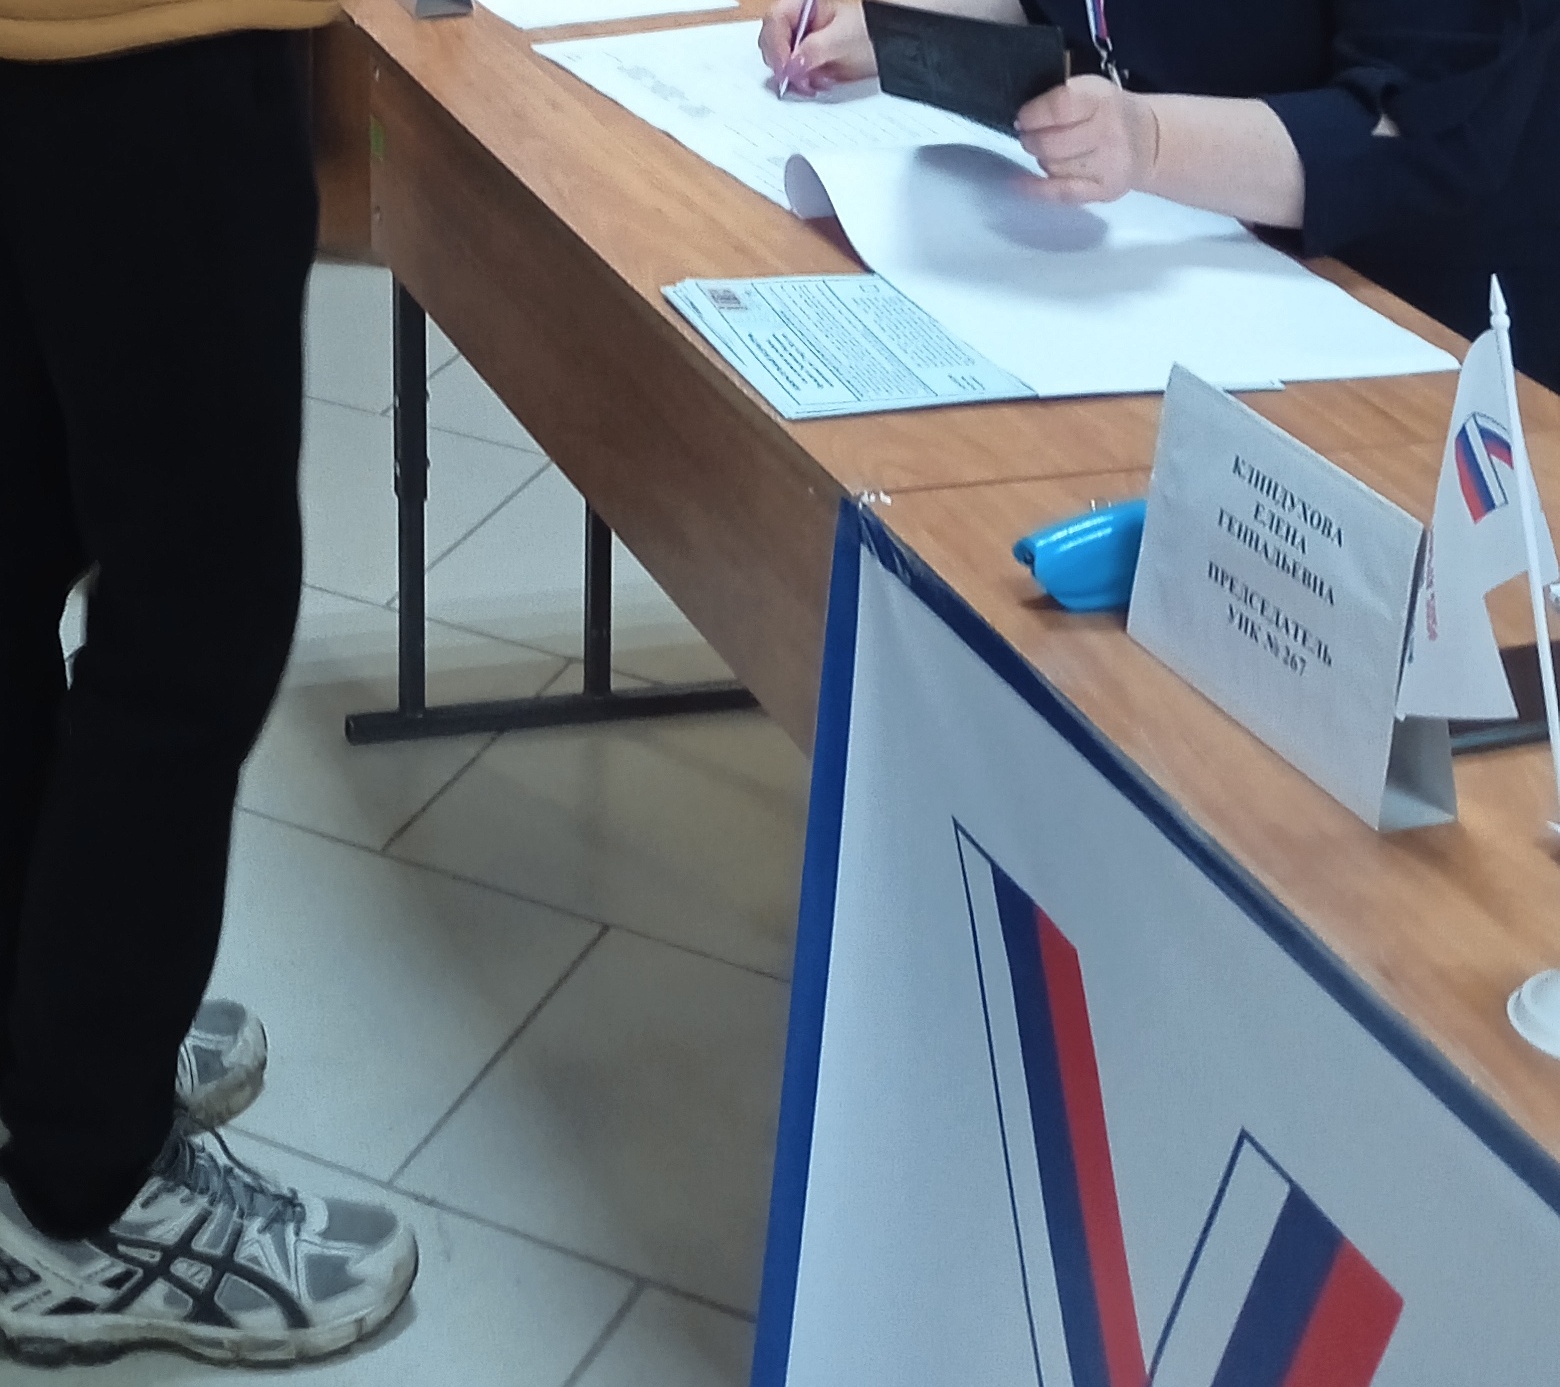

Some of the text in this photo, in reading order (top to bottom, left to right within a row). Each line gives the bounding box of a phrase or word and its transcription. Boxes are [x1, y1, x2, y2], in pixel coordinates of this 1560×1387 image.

[1232, 454, 1343, 549] КЛИНДУХОВА
[1253, 500, 1307, 556] ЕЛЕНА
[1217, 507, 1335, 607] ГЕННАДЬЕВНА
[1207, 560, 1332, 668] ПРЕДСЕДАТЕЛЬ
[1227, 603, 1307, 676] УИК № 267
